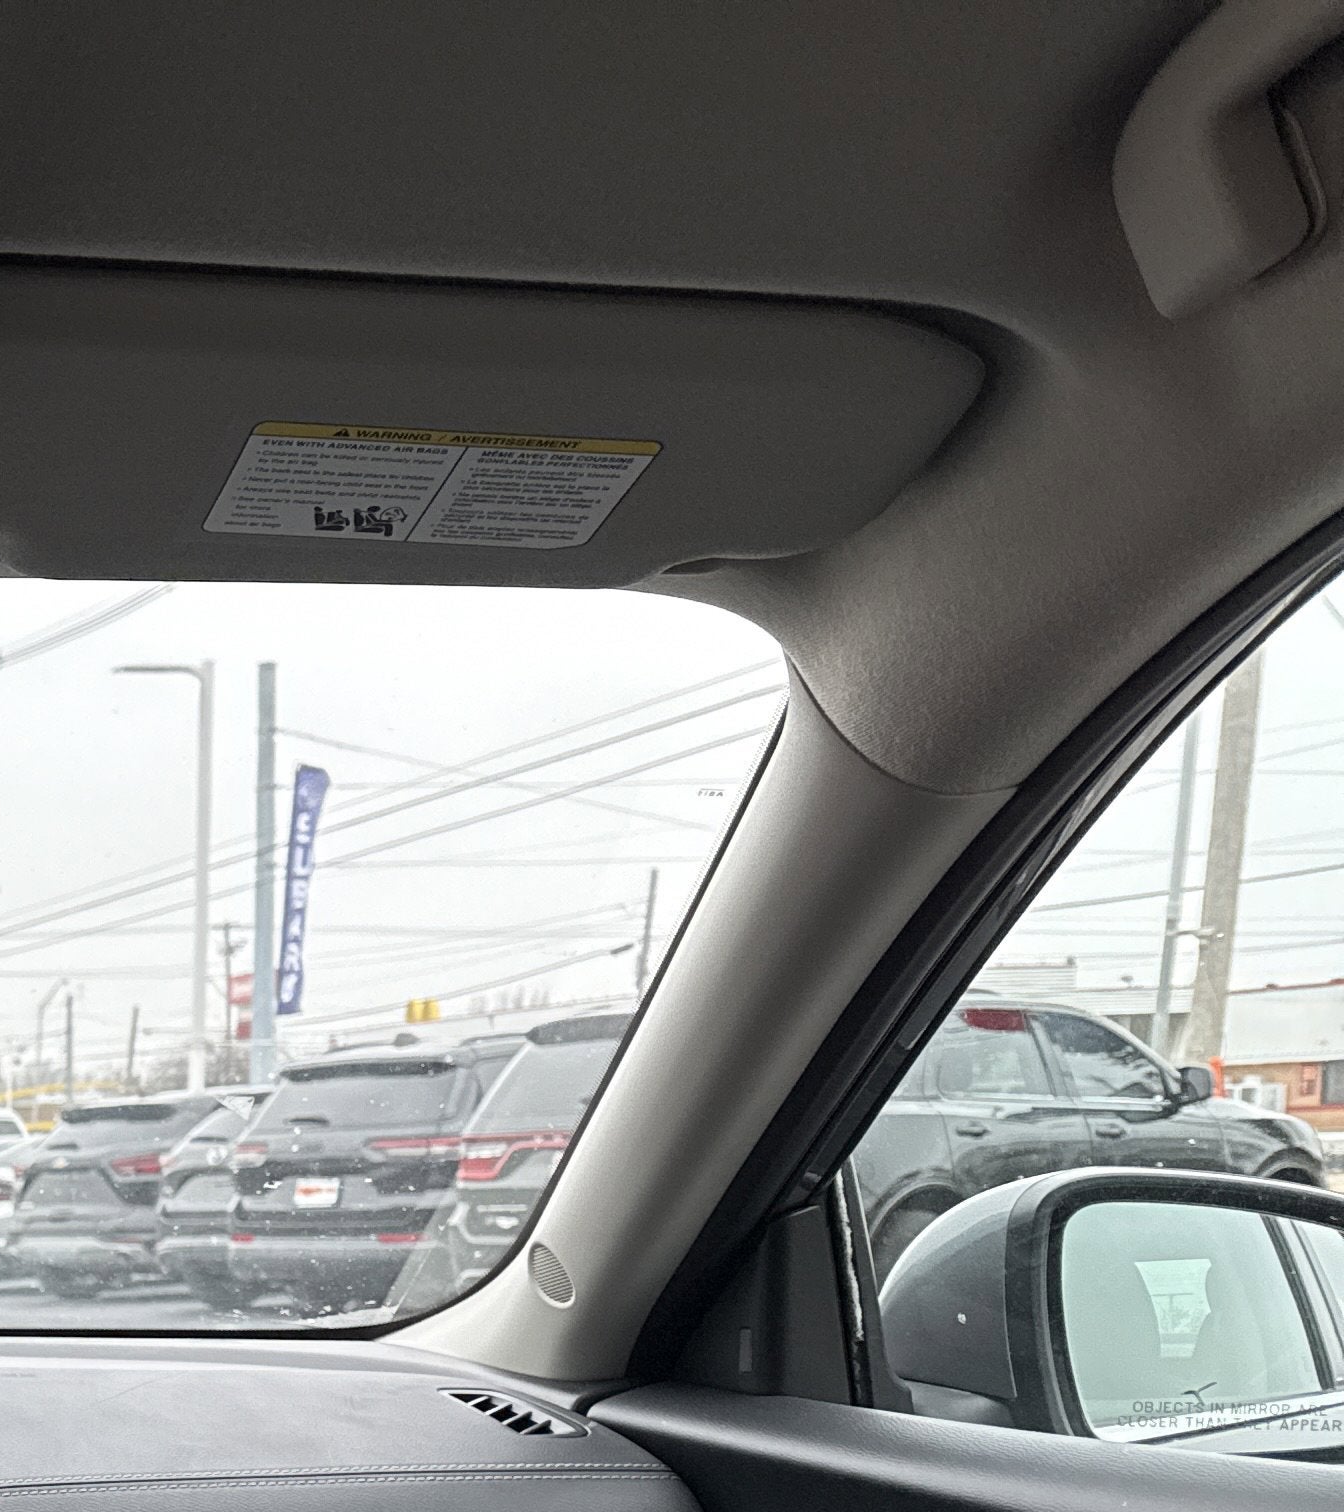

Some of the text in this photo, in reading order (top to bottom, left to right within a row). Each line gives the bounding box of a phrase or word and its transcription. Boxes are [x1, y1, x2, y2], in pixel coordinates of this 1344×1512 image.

[263, 439, 294, 447] EVEN
[295, 440, 326, 448] WITH
[328, 442, 391, 452] ADVANCED
[416, 446, 448, 455] BAGS
[356, 430, 431, 441] WARNING
[450, 435, 582, 449] AVERTISSEMENT
[1132, 1401, 1205, 1414] OBJECTS
[1210, 1402, 1226, 1414] IN
[1230, 1402, 1291, 1416] MIRROR
[1117, 1416, 1179, 1428] CLOSER
[1185, 1416, 1227, 1429] THAN
[1279, 1419, 1343, 1432] APPEAR
